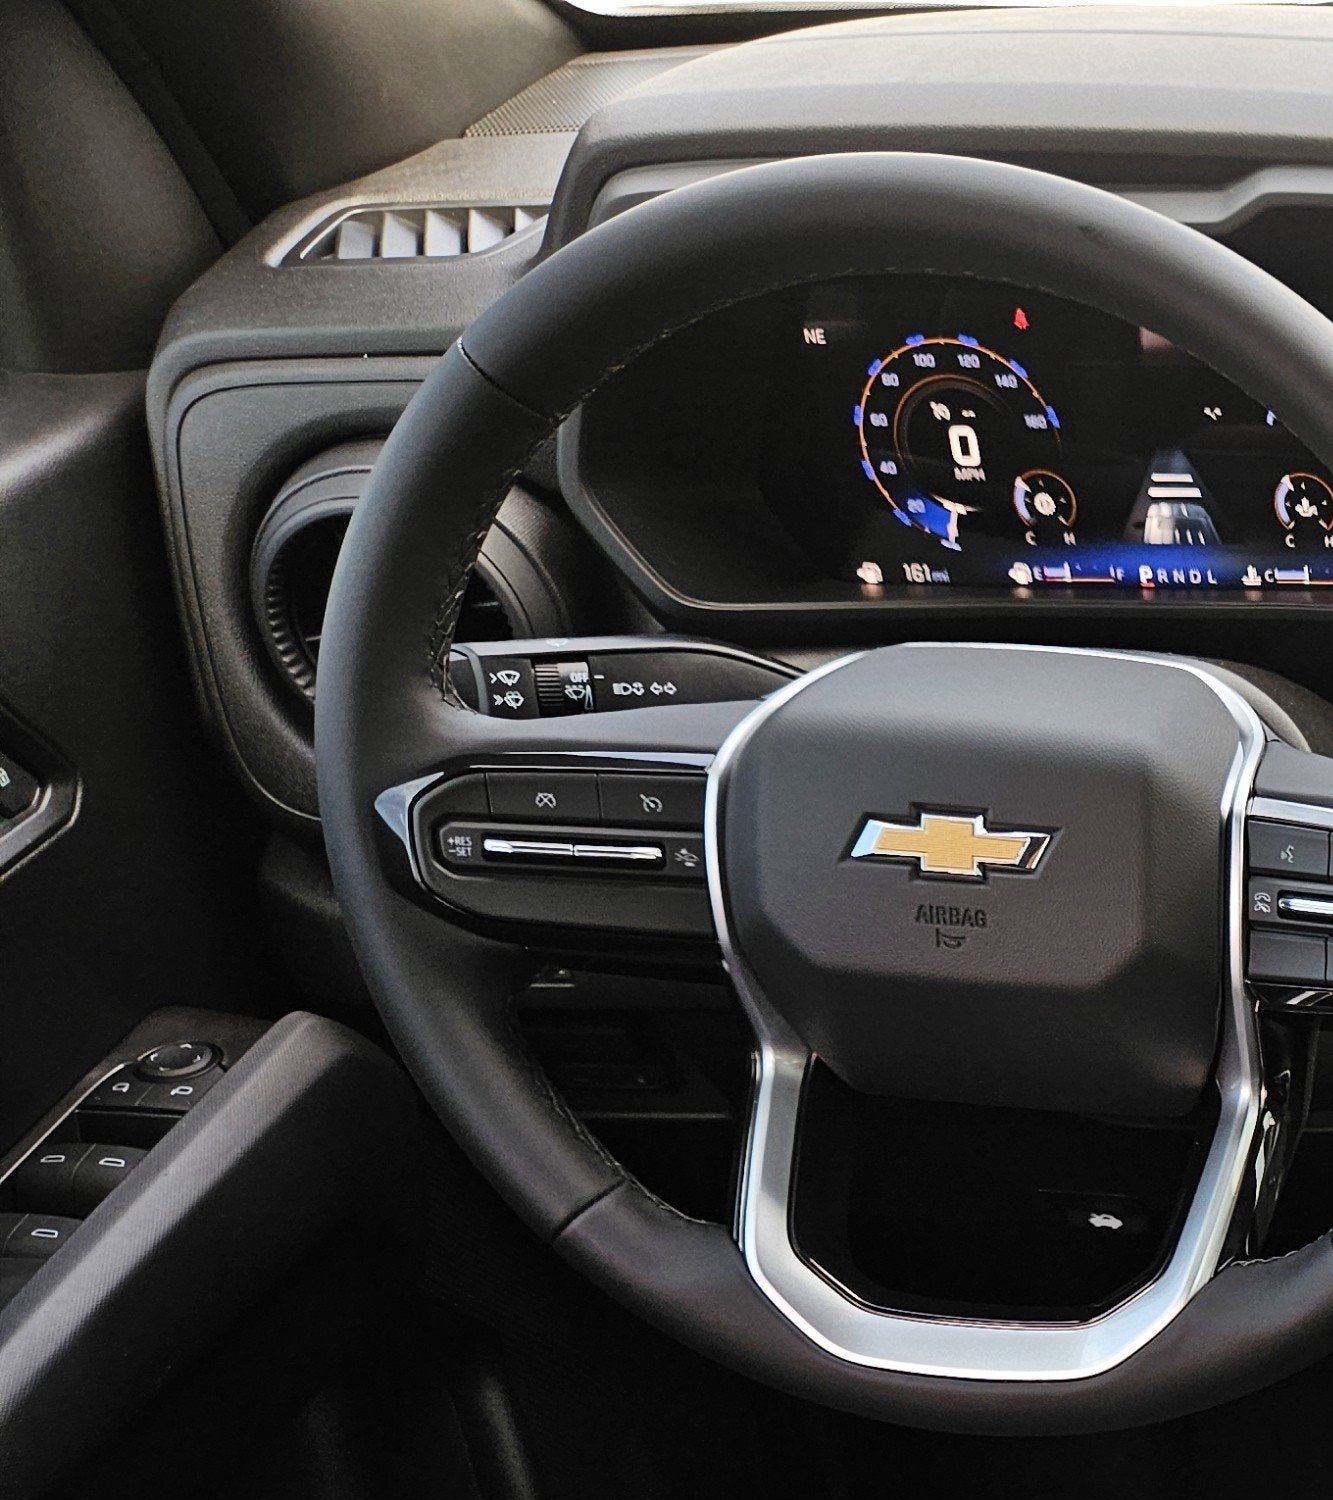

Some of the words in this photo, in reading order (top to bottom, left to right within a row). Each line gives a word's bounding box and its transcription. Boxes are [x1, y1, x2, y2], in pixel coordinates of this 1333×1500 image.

[803, 327, 827, 345] NE
[912, 353, 936, 368] 100
[957, 353, 981, 369] 120
[994, 374, 1018, 389] 140
[948, 425, 981, 467] 0
[954, 466, 986, 481] MPH
[1025, 530, 1038, 546] C
[1063, 530, 1077, 546] H
[1284, 533, 1296, 548] C
[1138, 564, 1153, 584] P
[1157, 569, 1169, 584] R
[1173, 569, 1186, 584] N
[1189, 569, 1202, 584] D
[1207, 569, 1218, 585] L
[1264, 568, 1274, 583] C
[570, 672, 589, 684] OFF
[915, 903, 987, 928] AIRBAG
